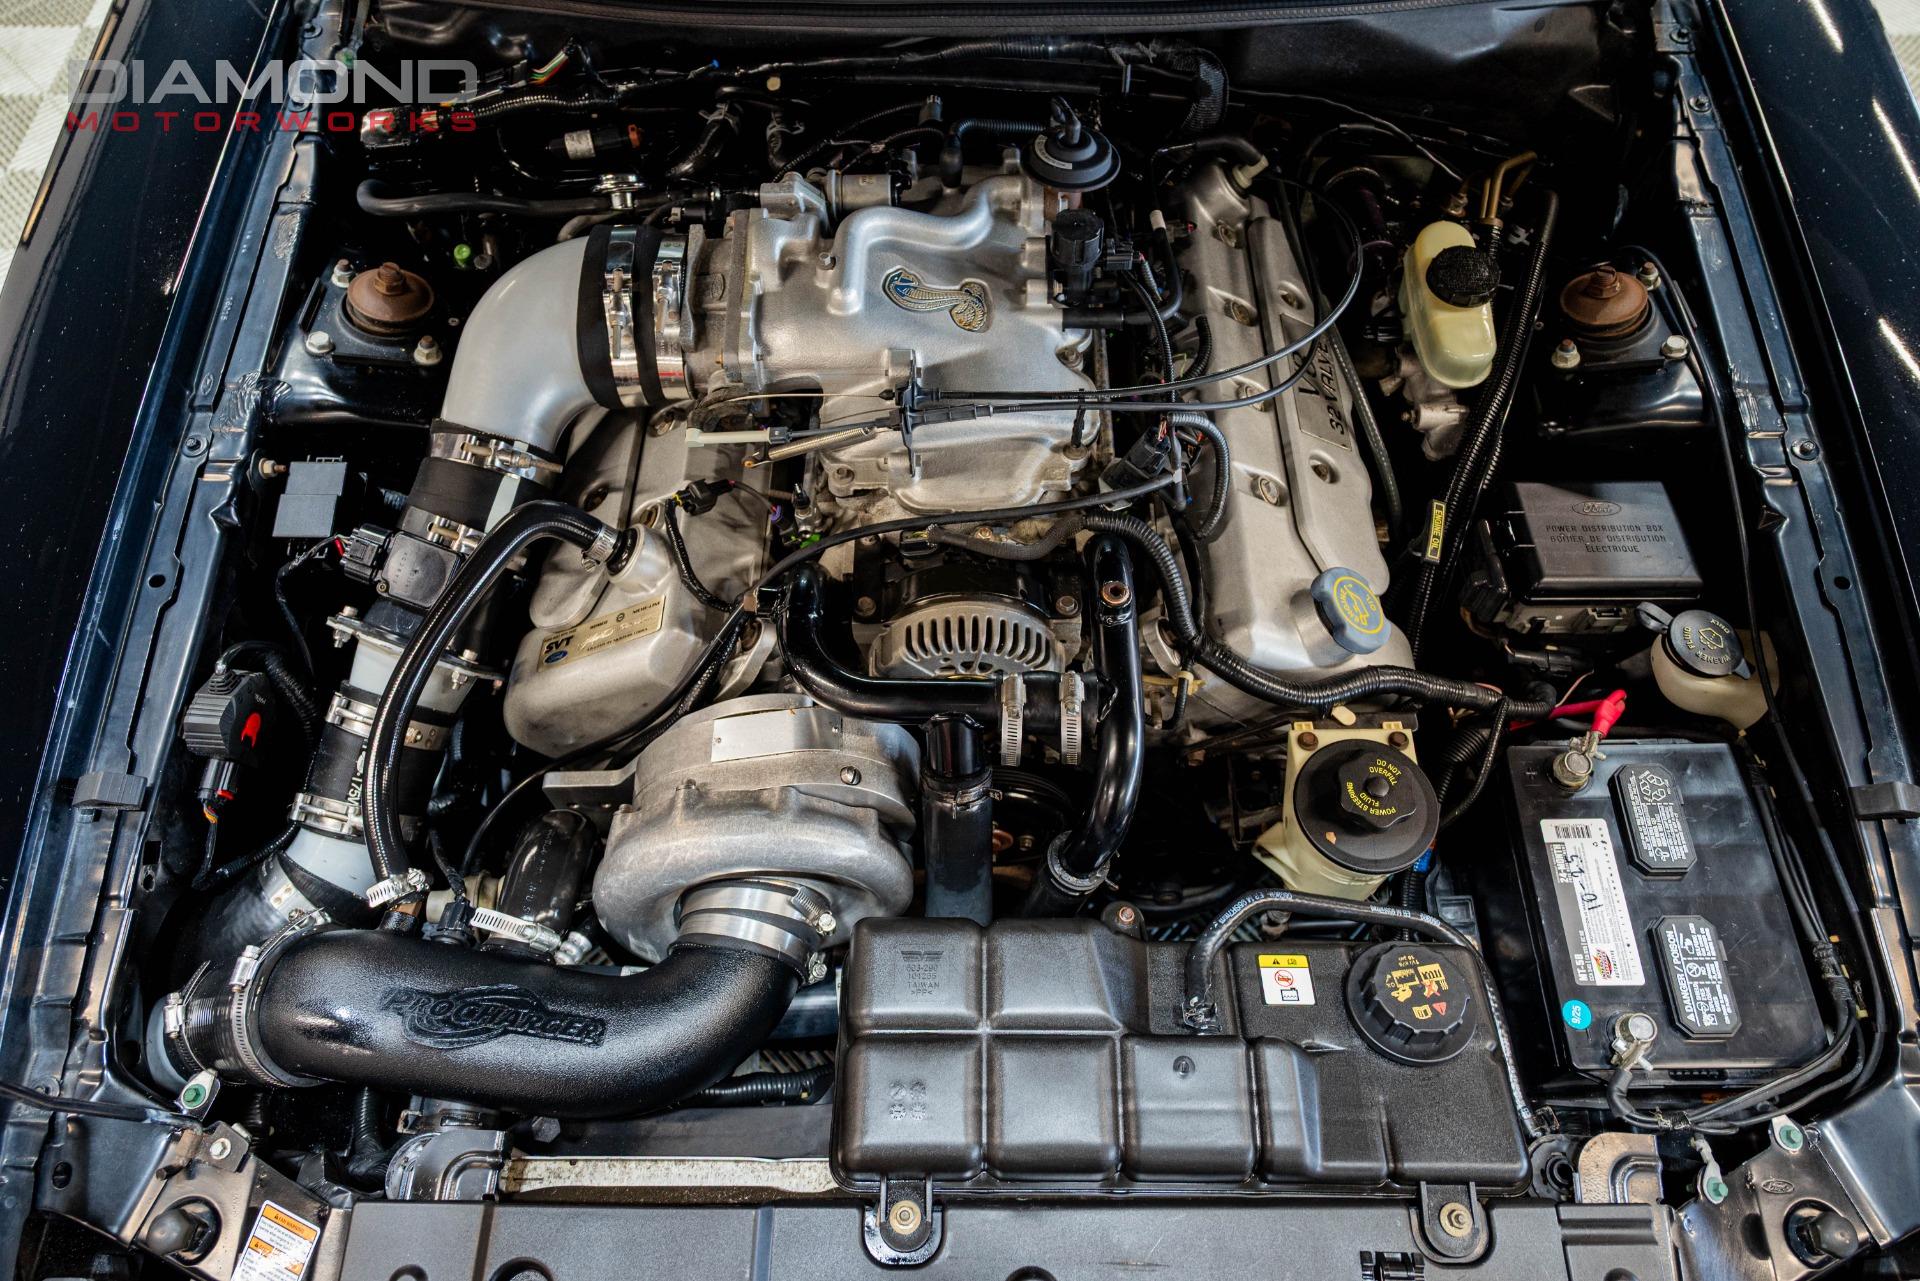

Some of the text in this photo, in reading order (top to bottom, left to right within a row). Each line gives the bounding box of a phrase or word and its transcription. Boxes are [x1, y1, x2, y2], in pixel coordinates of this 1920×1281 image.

[1317, 343, 1345, 435] 32 VALVE
[1431, 509, 1443, 549] ENGINE OIL
[1340, 587, 1377, 623] ENGINE OIL
[1710, 618, 1730, 634] ONLY
[544, 634, 575, 655] SVT
[1683, 626, 1731, 665] WASHER FLUID
[1368, 766, 1398, 786] OVERFILL
[1376, 758, 1402, 776] DO NOT
[1346, 781, 1397, 816] POWER STEERING
[1359, 792, 1380, 807] FLUID
[1552, 843, 1569, 883] 24-MONTH
[1610, 950, 1620, 978] AUTOMOTIVE
[1665, 930, 1681, 964] POISON
[907, 981, 940, 989] TAIWAN
[1676, 973, 1693, 1013] DANGER
